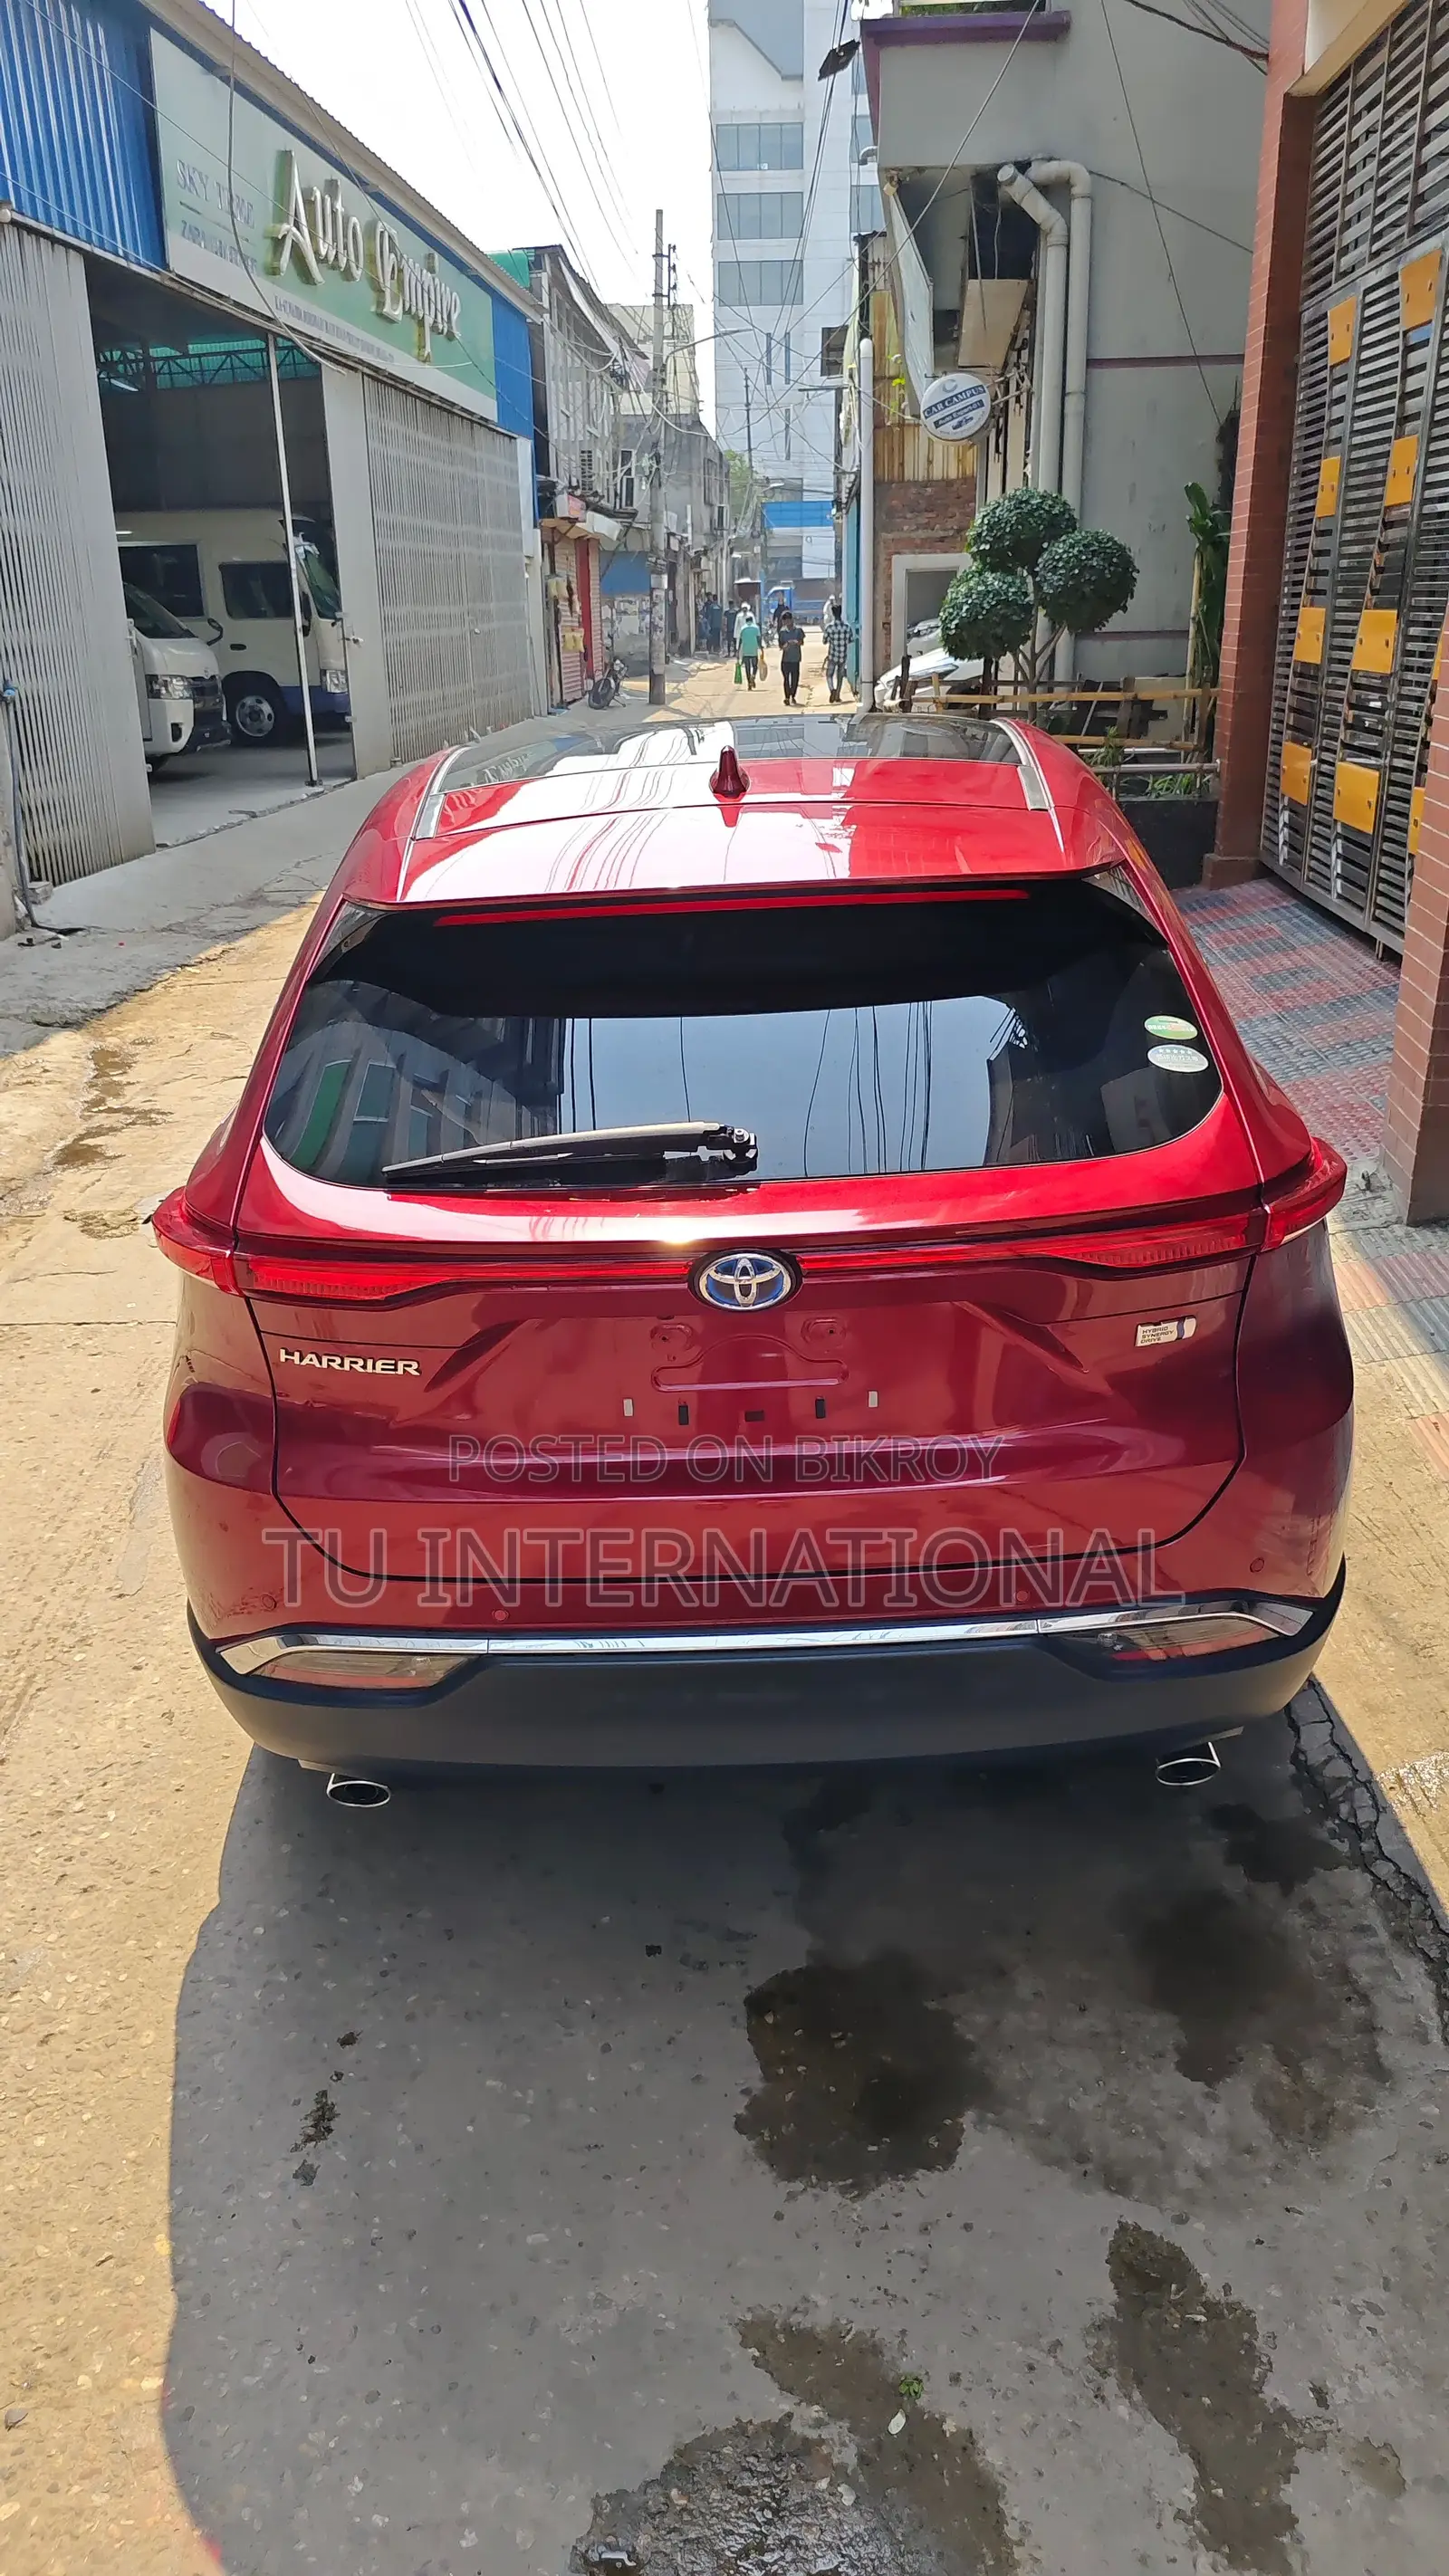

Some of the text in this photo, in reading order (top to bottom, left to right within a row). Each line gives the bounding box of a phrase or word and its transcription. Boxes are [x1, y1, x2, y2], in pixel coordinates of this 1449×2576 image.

[177, 159, 209, 202] SKY
[269, 149, 364, 286] Auto
[371, 221, 462, 362] Empire
[924, 403, 944, 417] CAR
[945, 387, 984, 406] CAMPUS
[1141, 1330, 1174, 1338] SYNERGY
[1142, 1326, 1168, 1335] HYBRID
[279, 1348, 421, 1376] HARRIER
